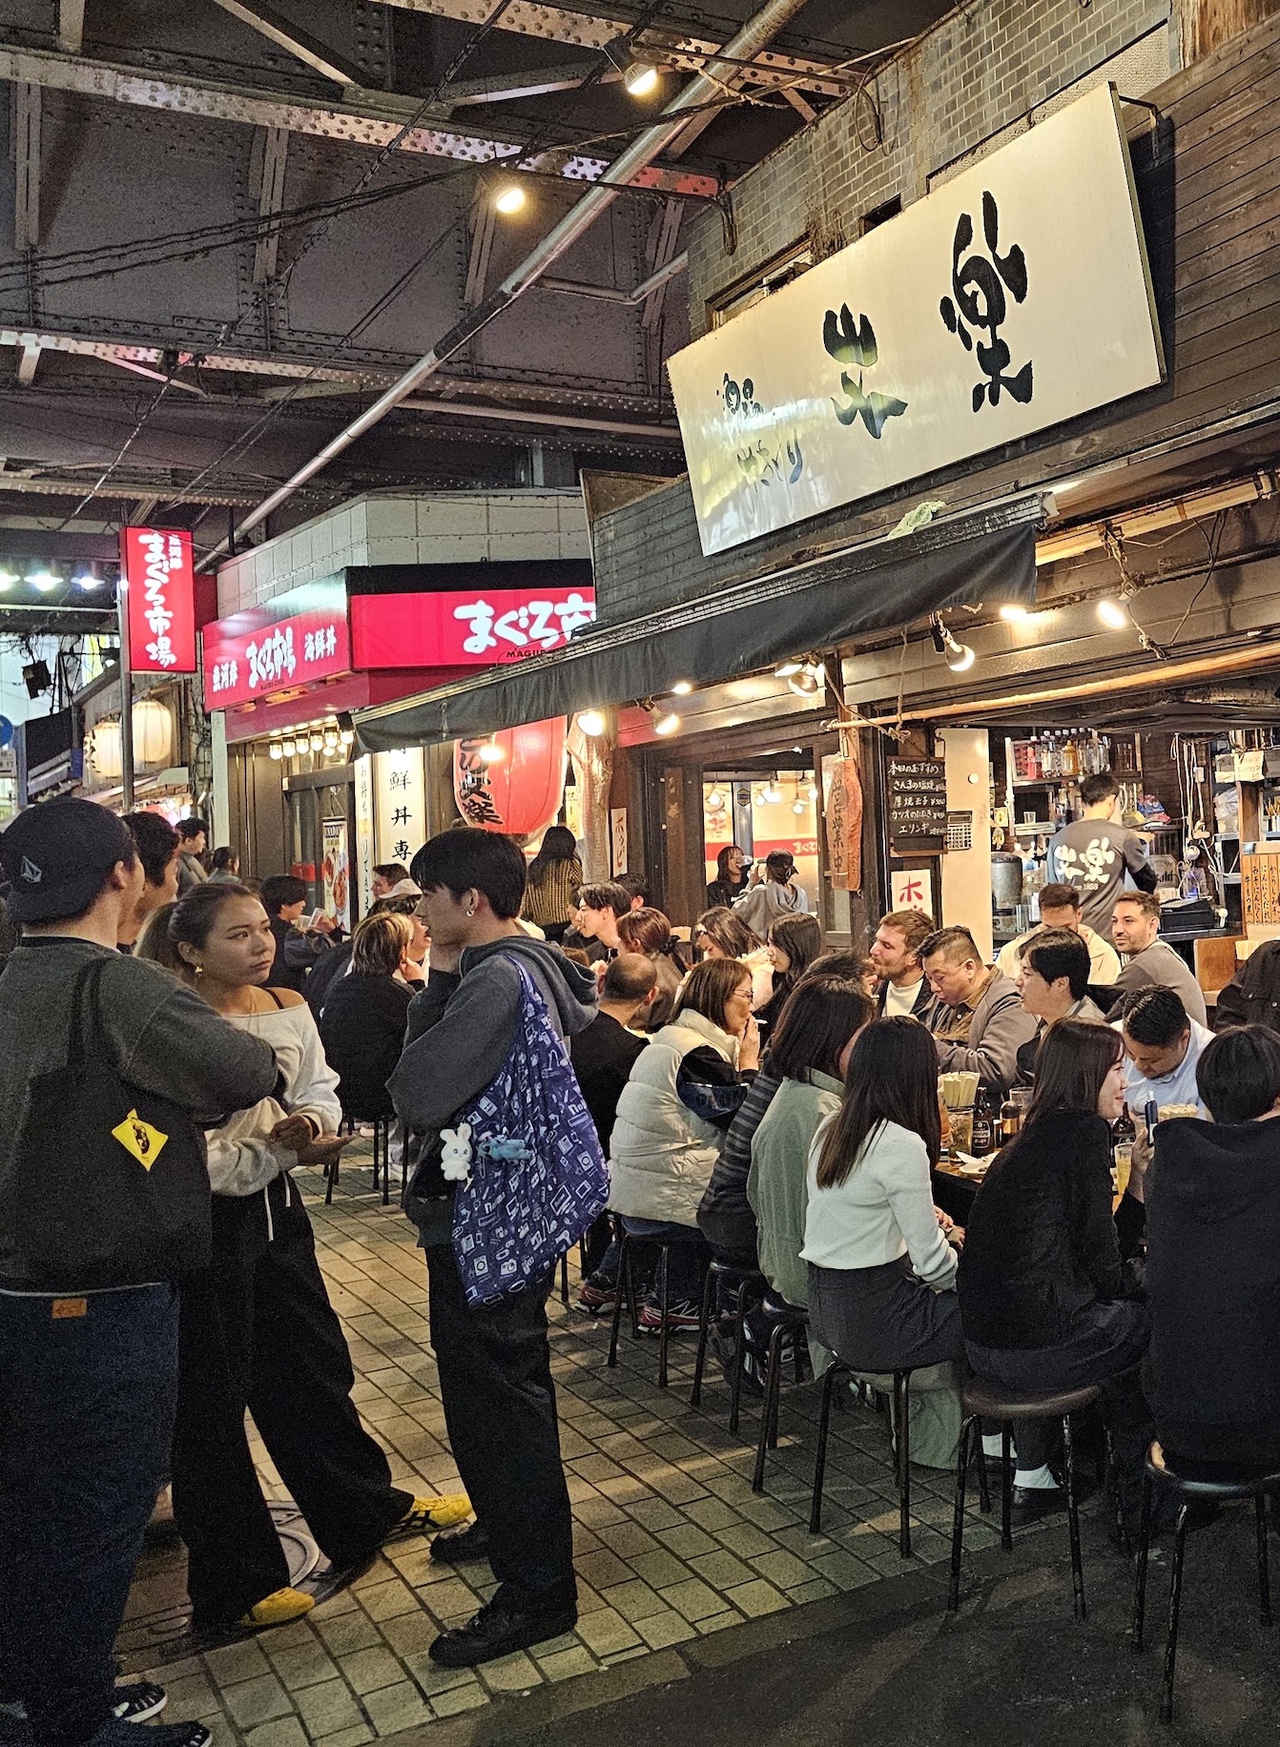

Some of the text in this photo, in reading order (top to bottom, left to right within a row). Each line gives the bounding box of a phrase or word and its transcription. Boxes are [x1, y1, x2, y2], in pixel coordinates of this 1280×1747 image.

[138, 532, 177, 668] まぐろ市場
[246, 626, 296, 688] まぐろ市場
[390, 748, 412, 861] 鮮丼専
